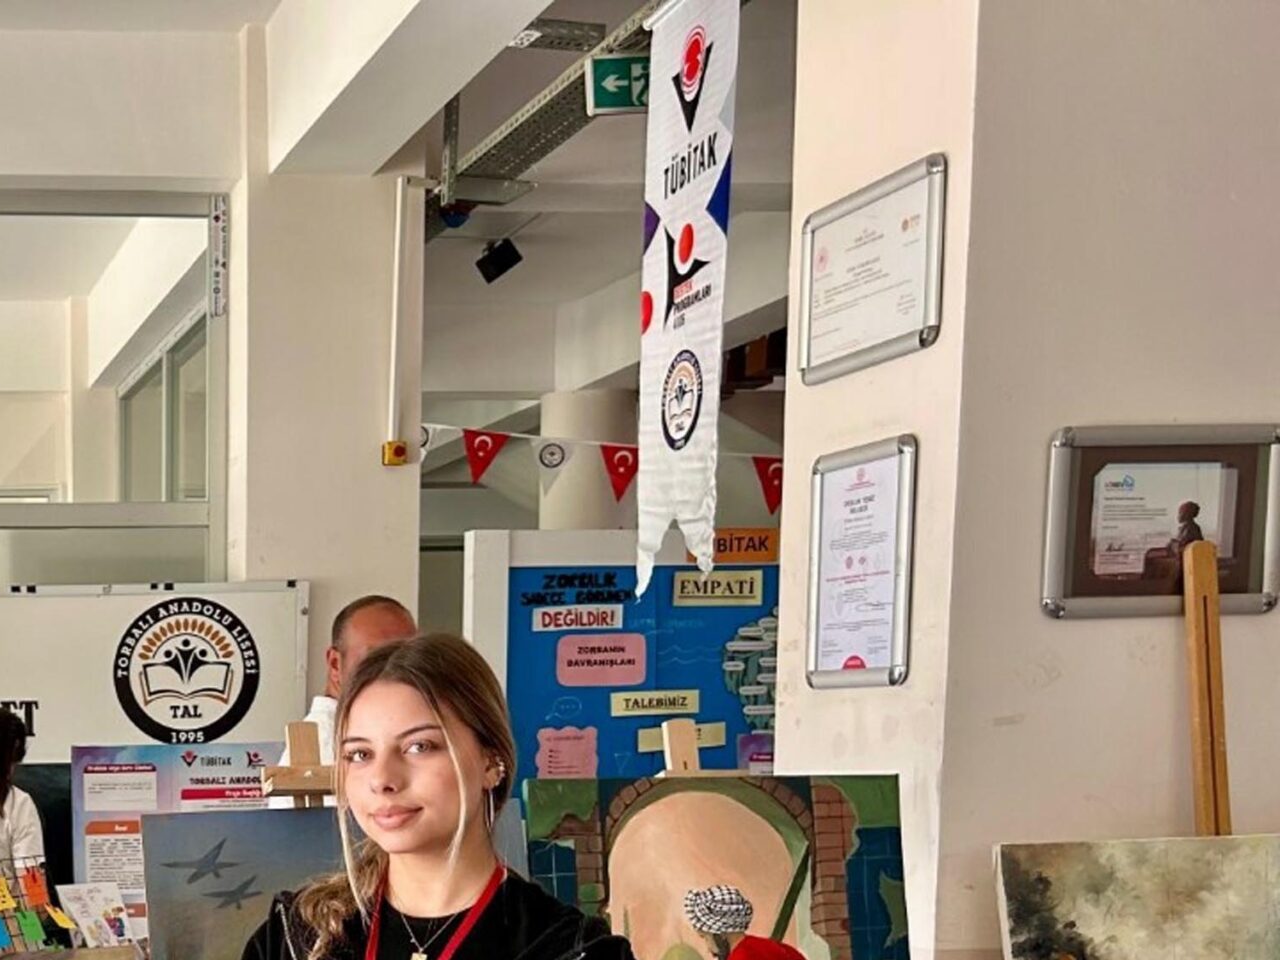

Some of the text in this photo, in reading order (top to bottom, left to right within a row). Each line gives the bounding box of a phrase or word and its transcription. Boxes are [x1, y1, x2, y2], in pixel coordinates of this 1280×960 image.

[663, 132, 718, 200] TÜBİTAK
[715, 533, 769, 553] BİTAK
[679, 577, 755, 594] EMPATİ
[541, 608, 615, 628] DEĞİLDİR!
[118, 602, 258, 678] TORBALI ANADOLU LİSESİ
[170, 705, 202, 718] TAL
[171, 732, 205, 742] 1995
